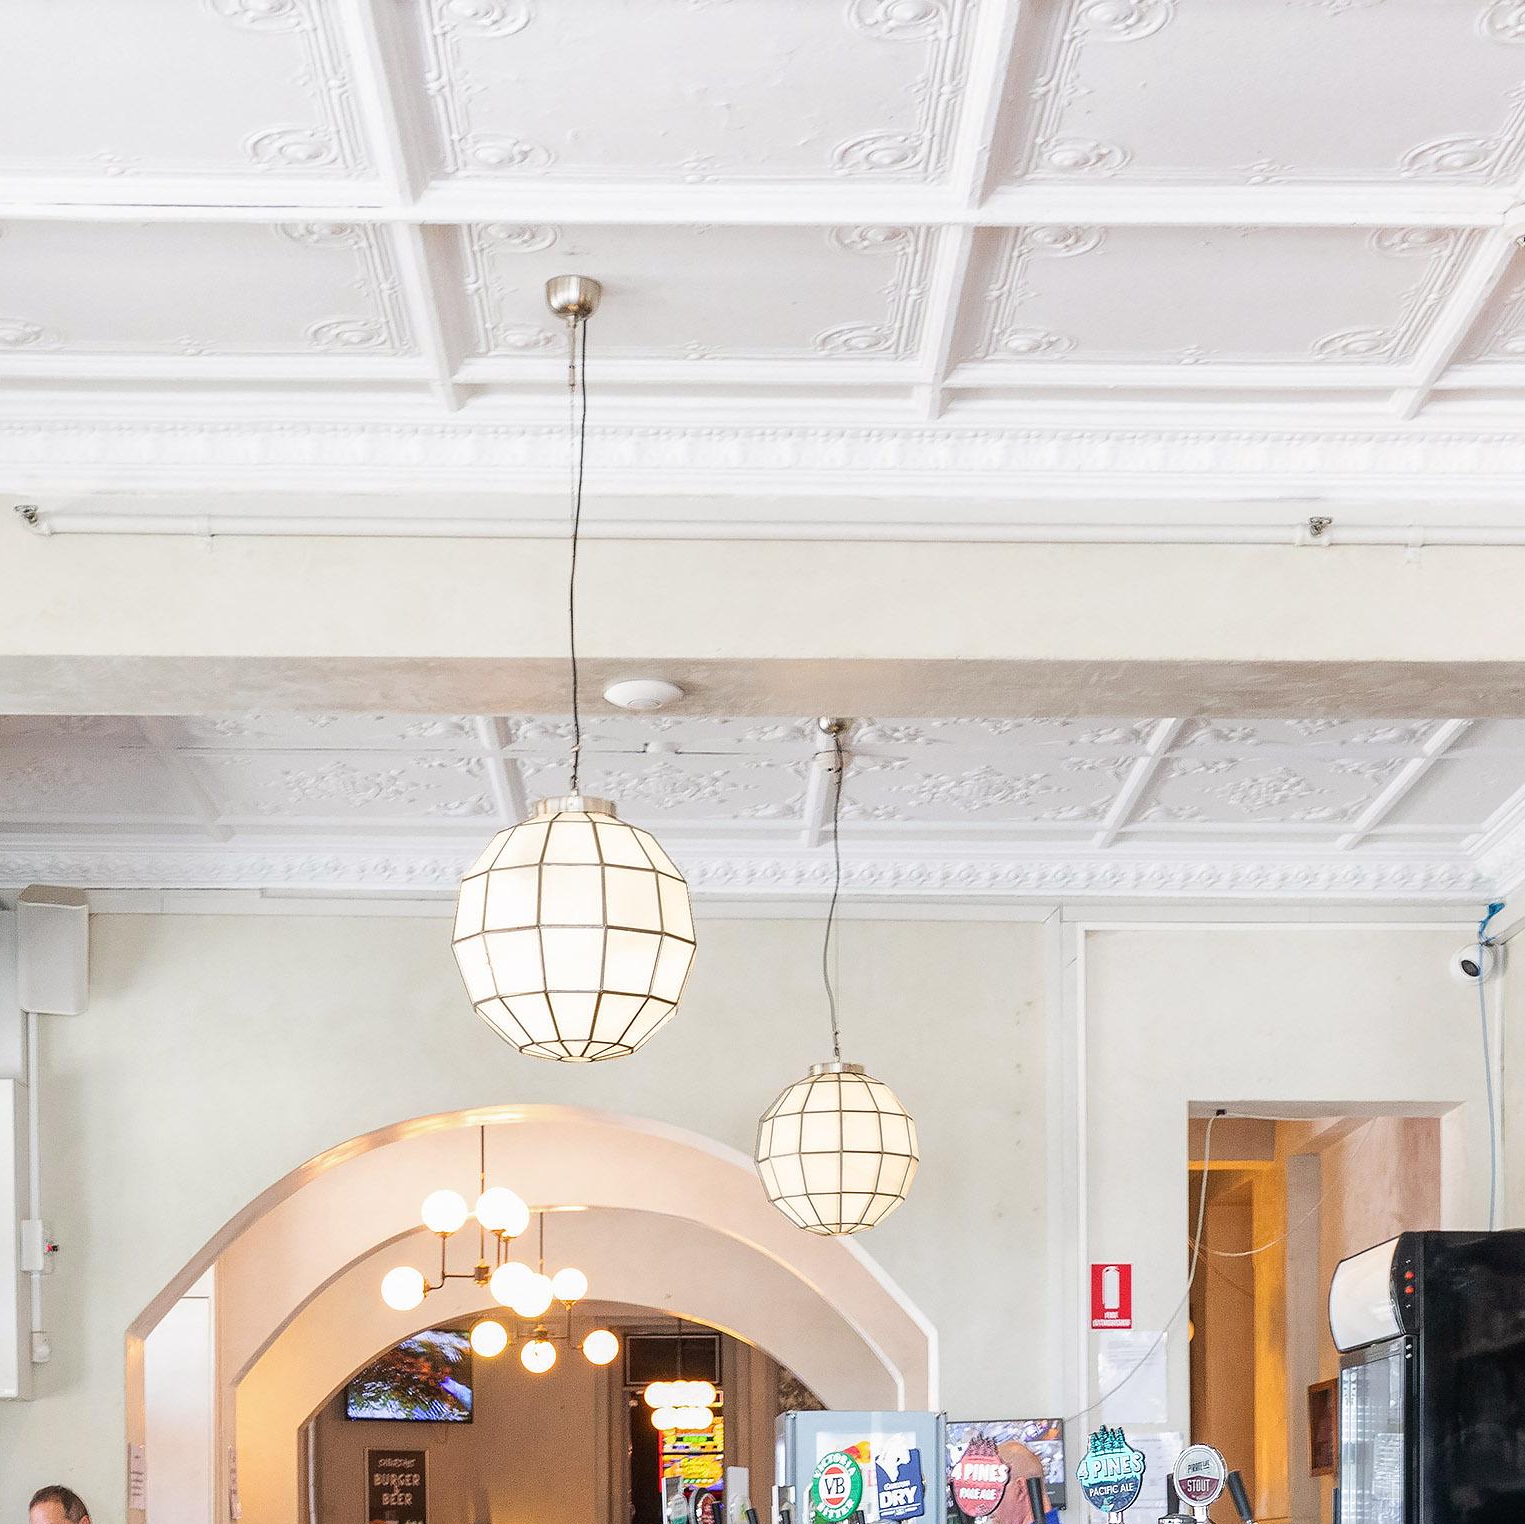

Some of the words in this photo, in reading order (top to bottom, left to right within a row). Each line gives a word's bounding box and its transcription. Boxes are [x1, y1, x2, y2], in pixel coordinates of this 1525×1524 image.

[814, 1452, 856, 1479] VICTORIA
[951, 1463, 963, 1481] 4
[964, 1463, 1009, 1483] PINES
[1077, 1459, 1089, 1481] 4
[1092, 1451, 1146, 1479] PINES
[374, 1473, 420, 1486] BURGER
[825, 1477, 845, 1494] VB
[1187, 1479, 1210, 1493] STOUT
[879, 1486, 917, 1508] DRY
[1089, 1485, 1119, 1497] PACIFIC
[1120, 1482, 1135, 1493] ALE
[382, 1493, 413, 1505] BEER
[817, 1498, 854, 1519] BITTER
